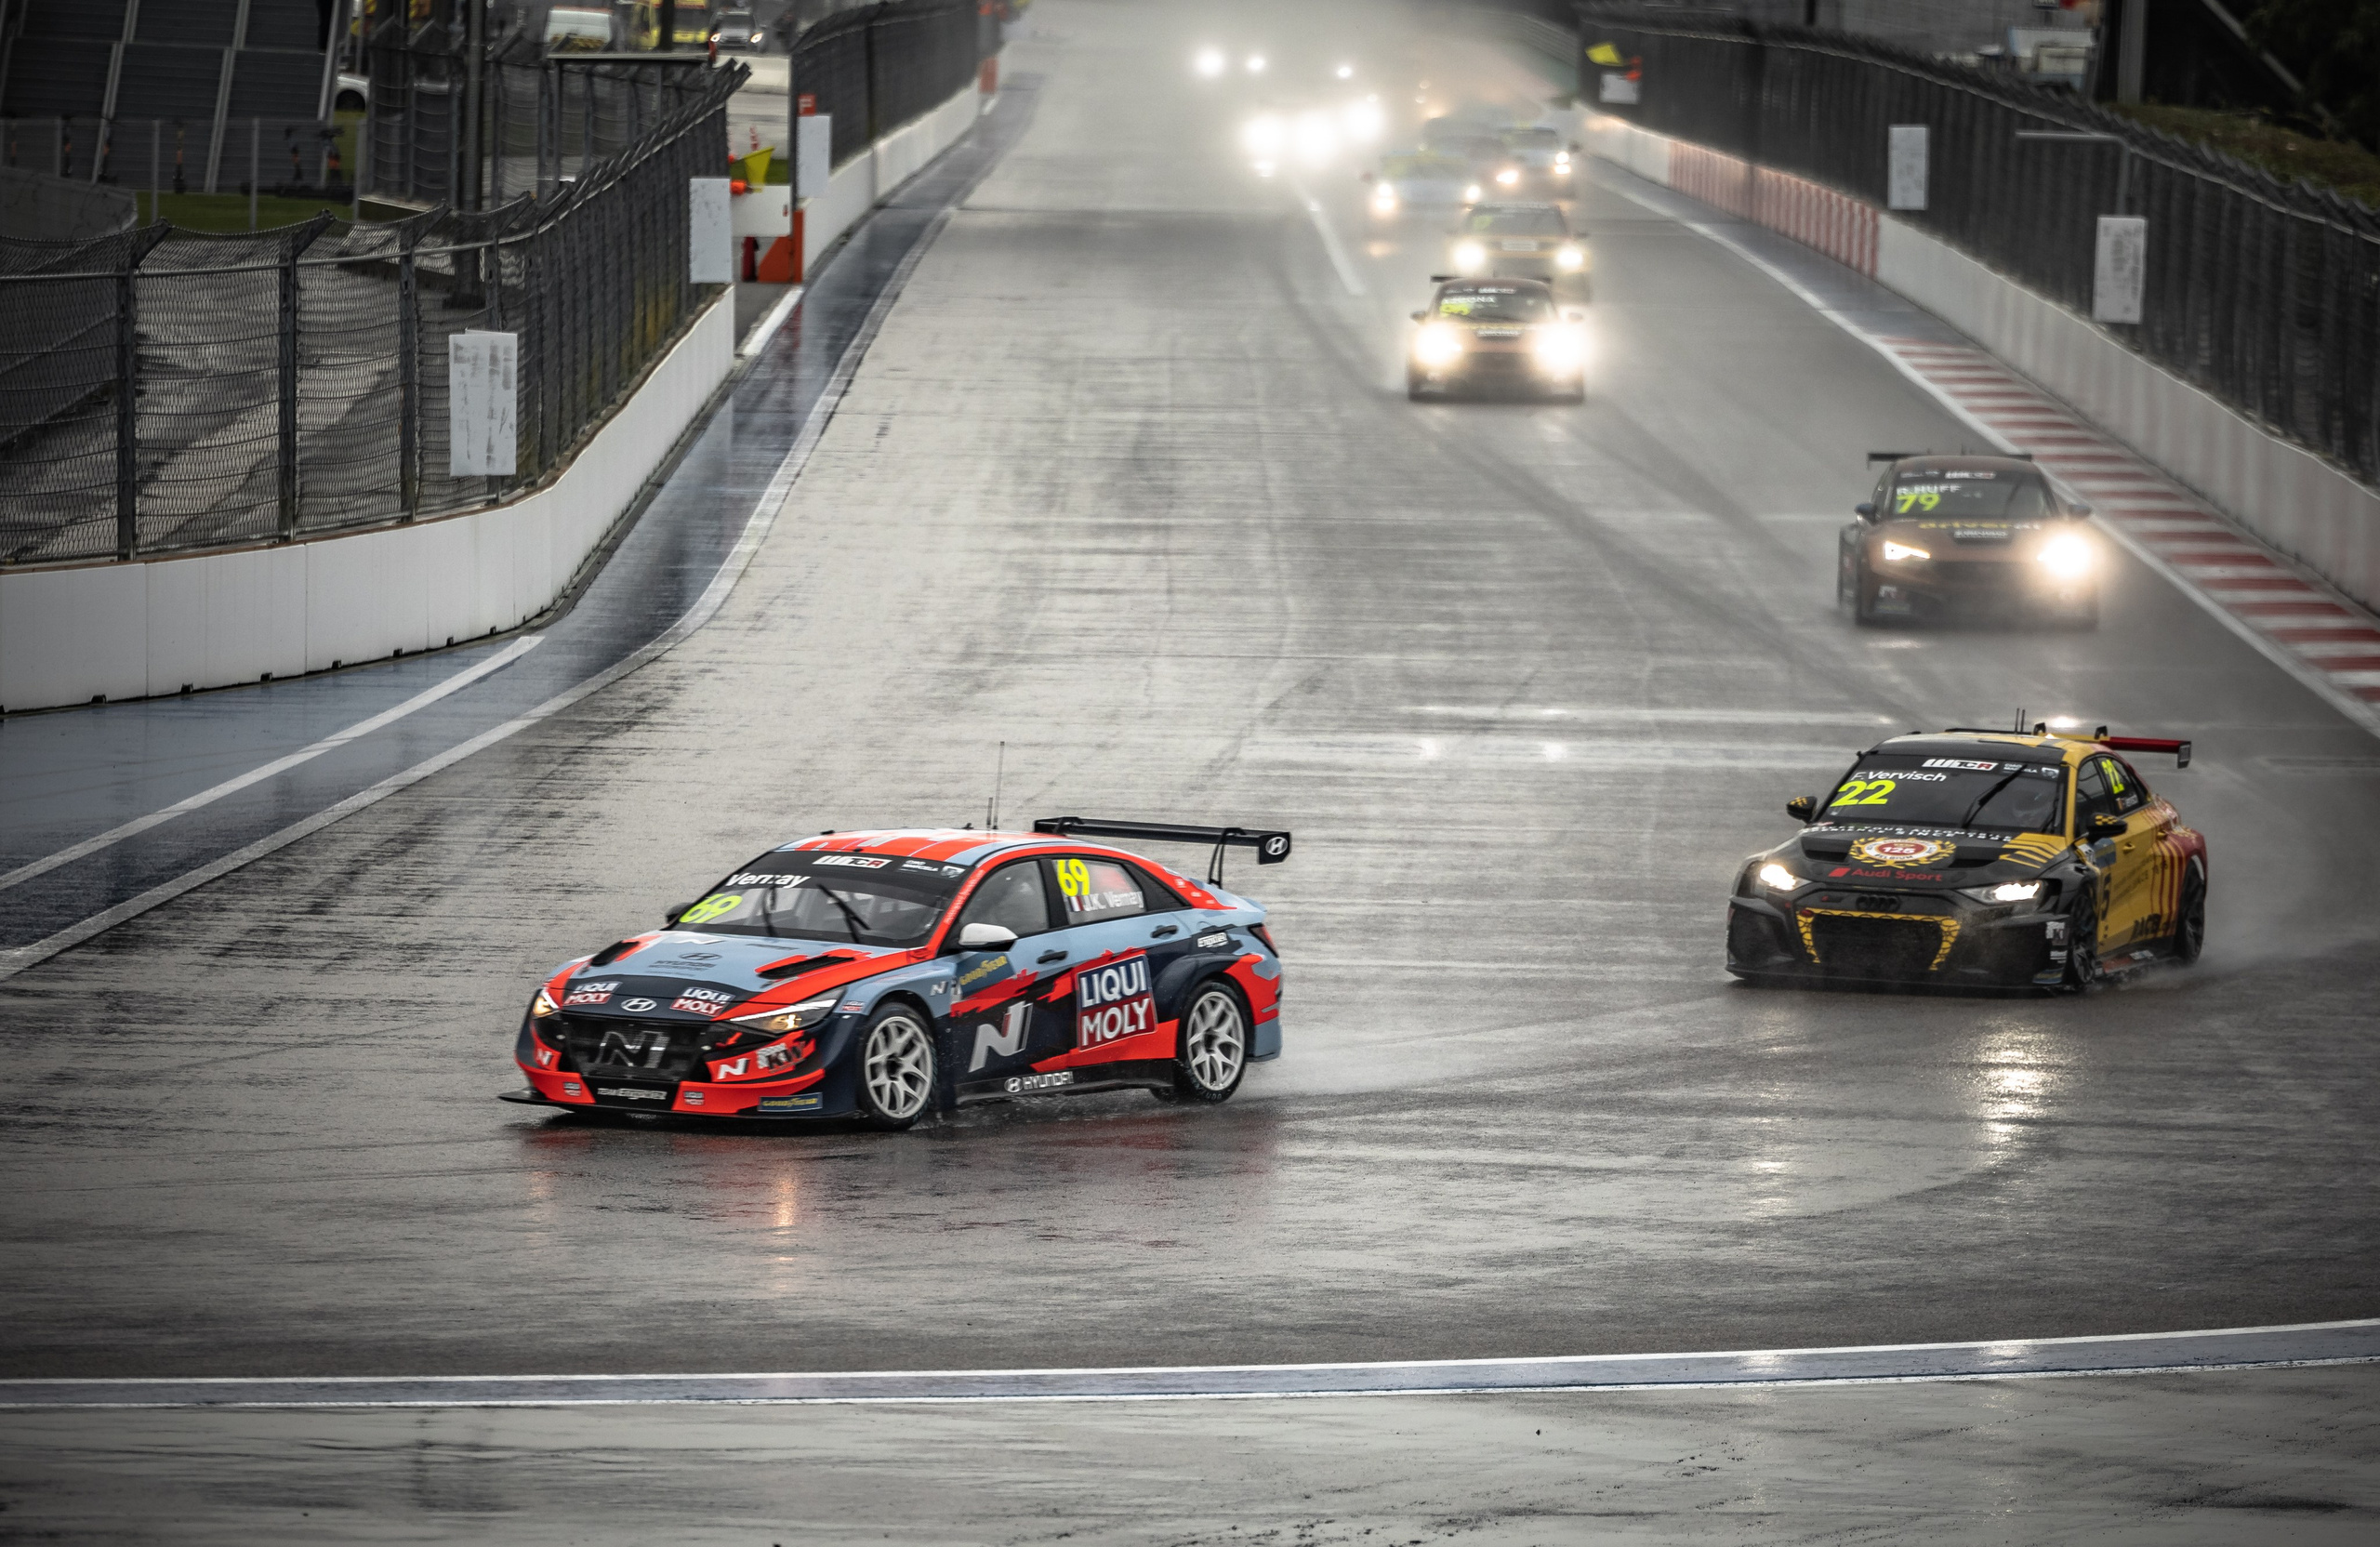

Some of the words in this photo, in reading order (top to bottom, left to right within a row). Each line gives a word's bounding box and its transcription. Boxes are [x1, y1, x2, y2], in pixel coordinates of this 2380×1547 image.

[1896, 493, 1941, 513] 79
[1830, 779, 1897, 807] 22
[1057, 858, 1090, 896] 69
[1851, 867, 1890, 879] Audi
[1895, 868, 1943, 882] Sport
[679, 893, 743, 923] 69
[681, 987, 732, 1002] LIQUI
[1080, 960, 1147, 1008] LIQUI
[564, 993, 611, 1005] MOLY
[674, 998, 723, 1016] MOLY
[1082, 998, 1150, 1047] MOLY
